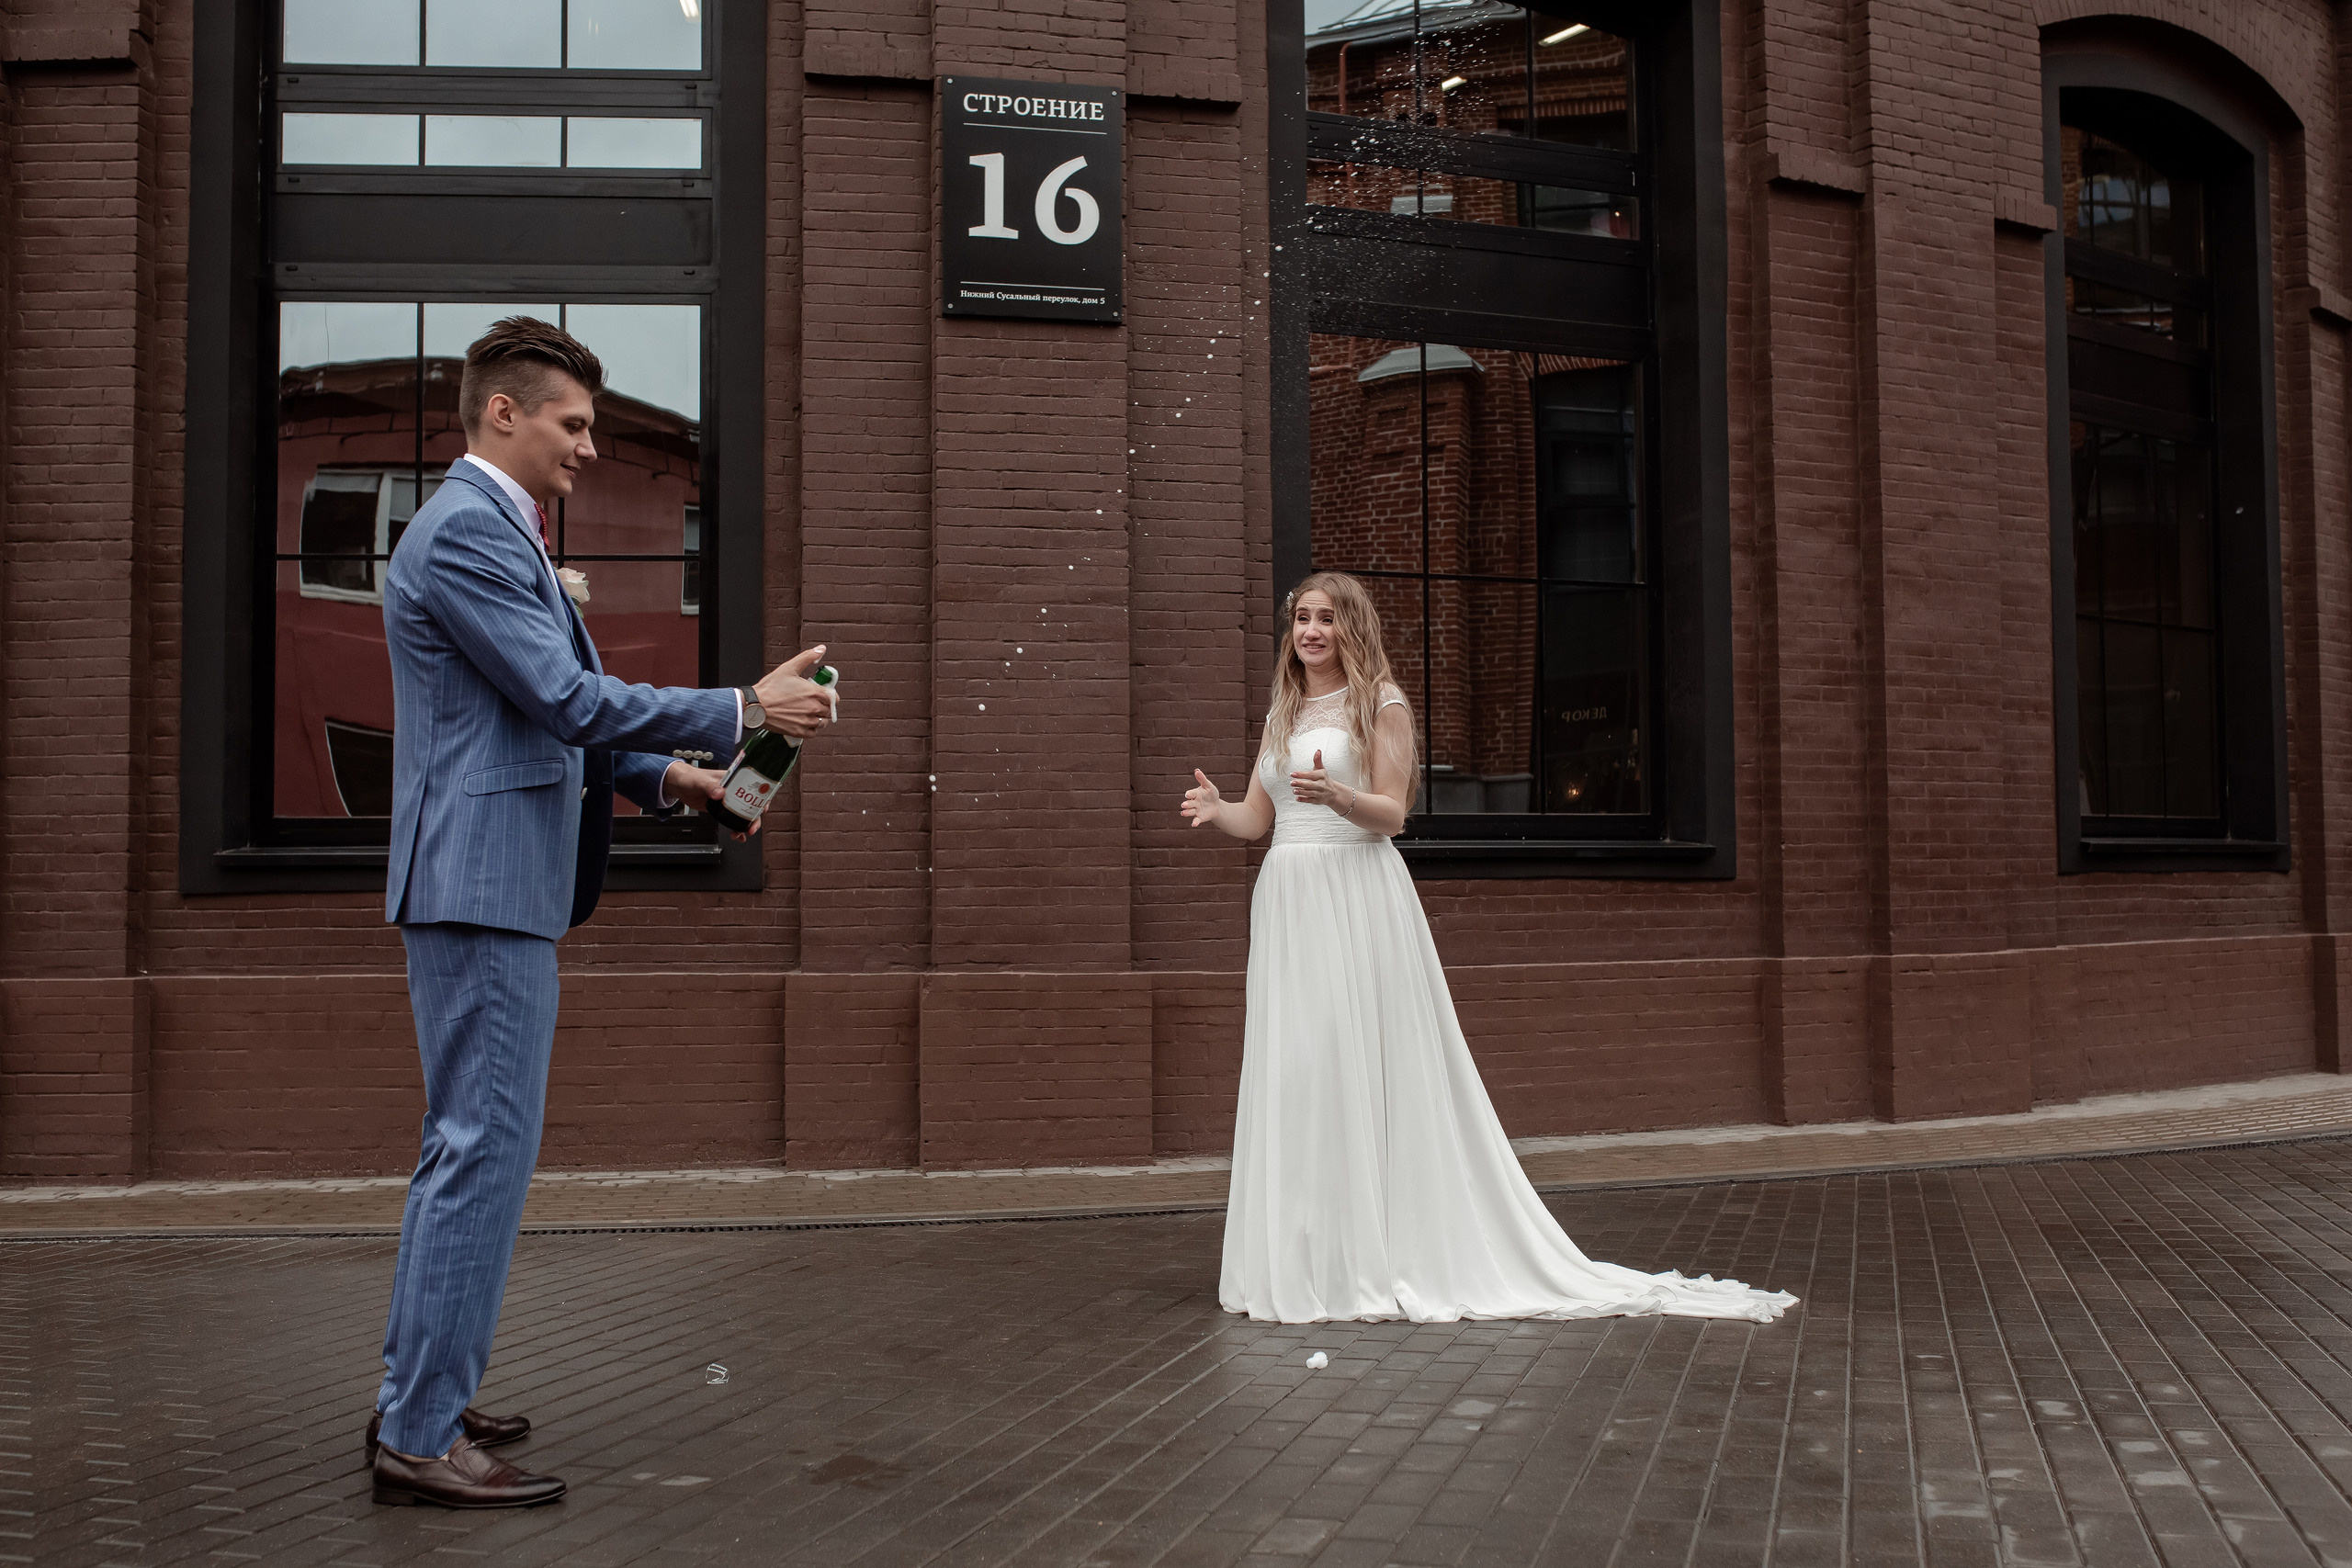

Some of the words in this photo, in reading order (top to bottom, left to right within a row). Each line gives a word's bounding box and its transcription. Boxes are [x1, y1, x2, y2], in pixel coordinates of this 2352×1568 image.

[963, 93, 1104, 120] СТРОЕНИЕ
[968, 152, 1100, 245] 16
[960, 289, 995, 299] Нижний
[996, 291, 1041, 301] Сусальный
[1042, 294, 1081, 304] переулок,
[1081, 297, 1098, 305] дом
[1100, 297, 1105, 305] 5
